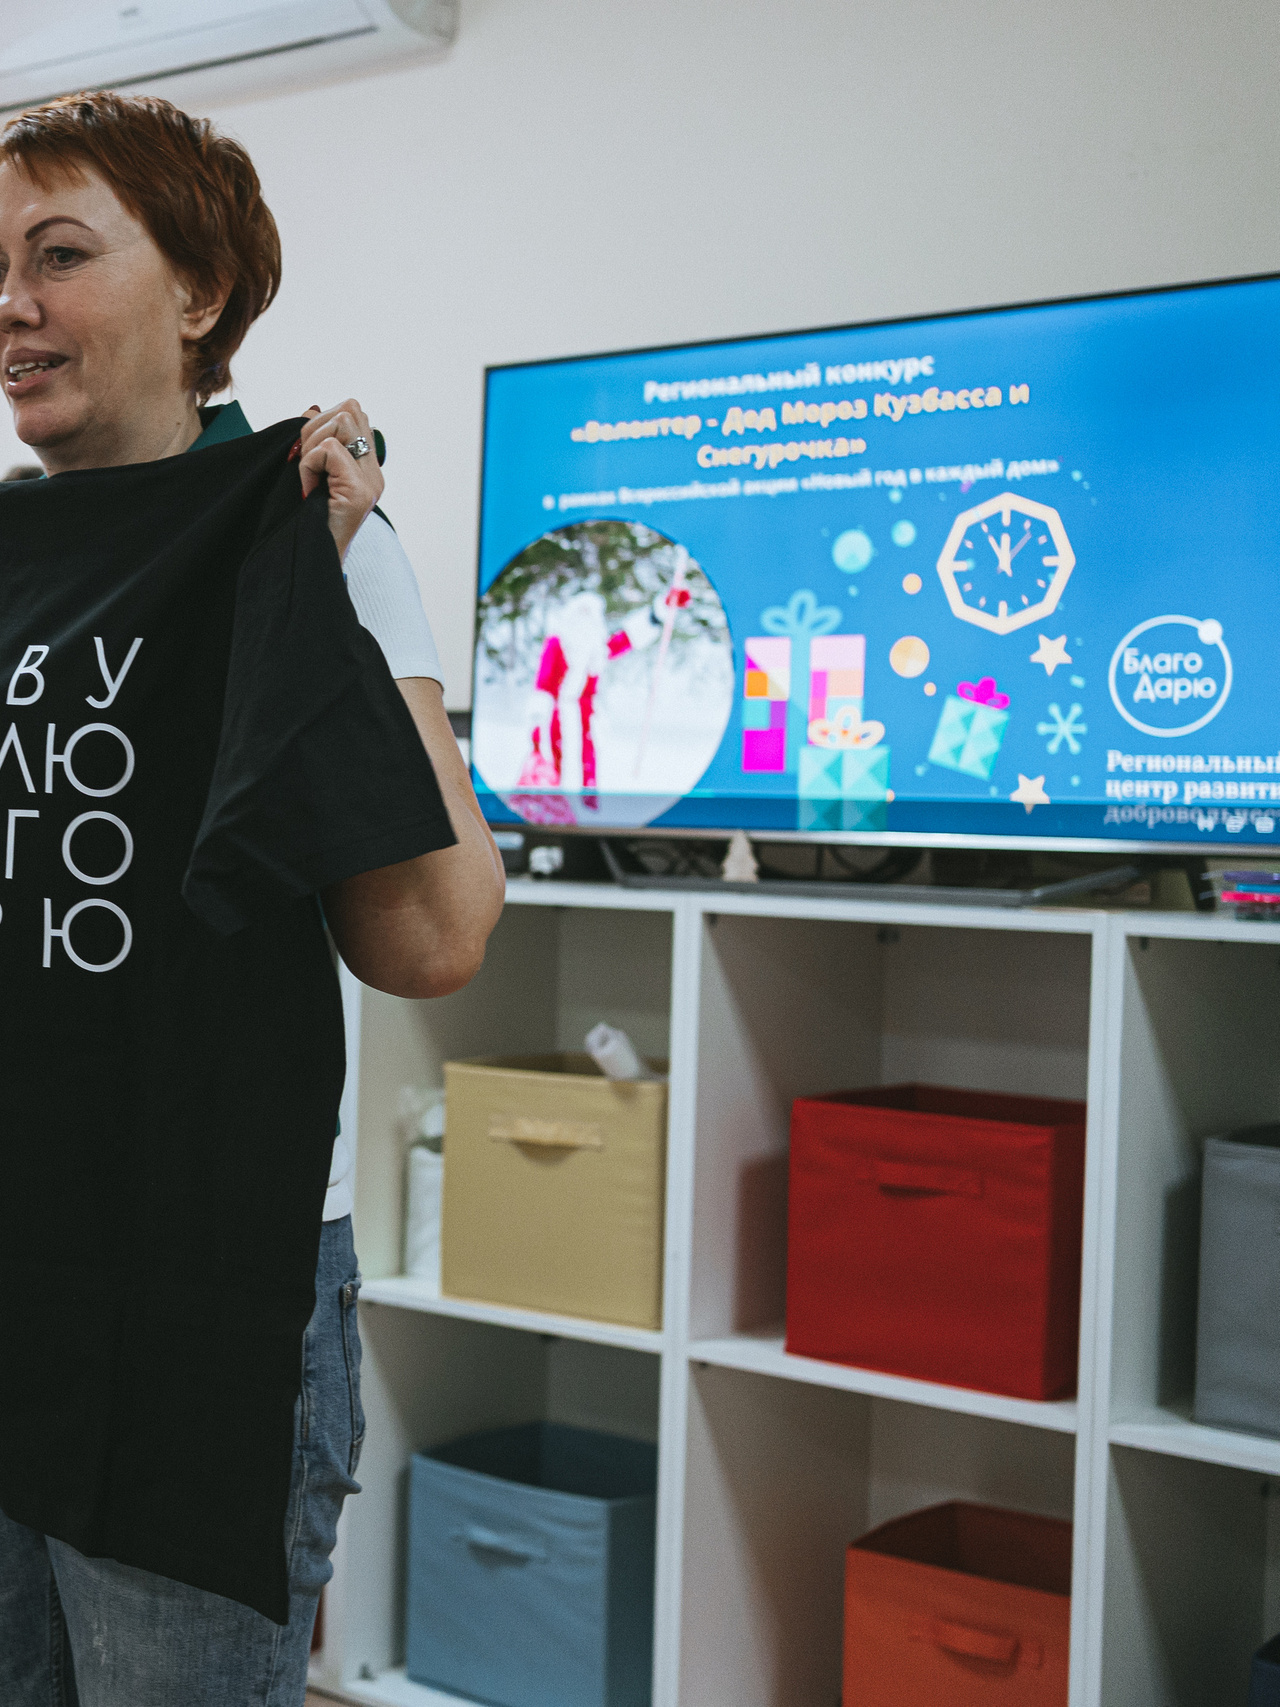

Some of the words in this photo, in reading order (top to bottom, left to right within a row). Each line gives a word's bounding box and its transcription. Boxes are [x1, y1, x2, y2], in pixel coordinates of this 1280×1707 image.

[824, 355, 935, 386] конкурс
[722, 406, 777, 435] Дед
[782, 398, 868, 428] Мороз
[873, 385, 1003, 421] Кузбасса
[1009, 383, 1030, 404] и
[697, 437, 867, 469] Снегурочка»
[1123, 647, 1203, 675] Благо
[1133, 671, 1217, 706] Дарю
[1107, 749, 1280, 774] Региональны
[1105, 779, 1179, 804] центр
